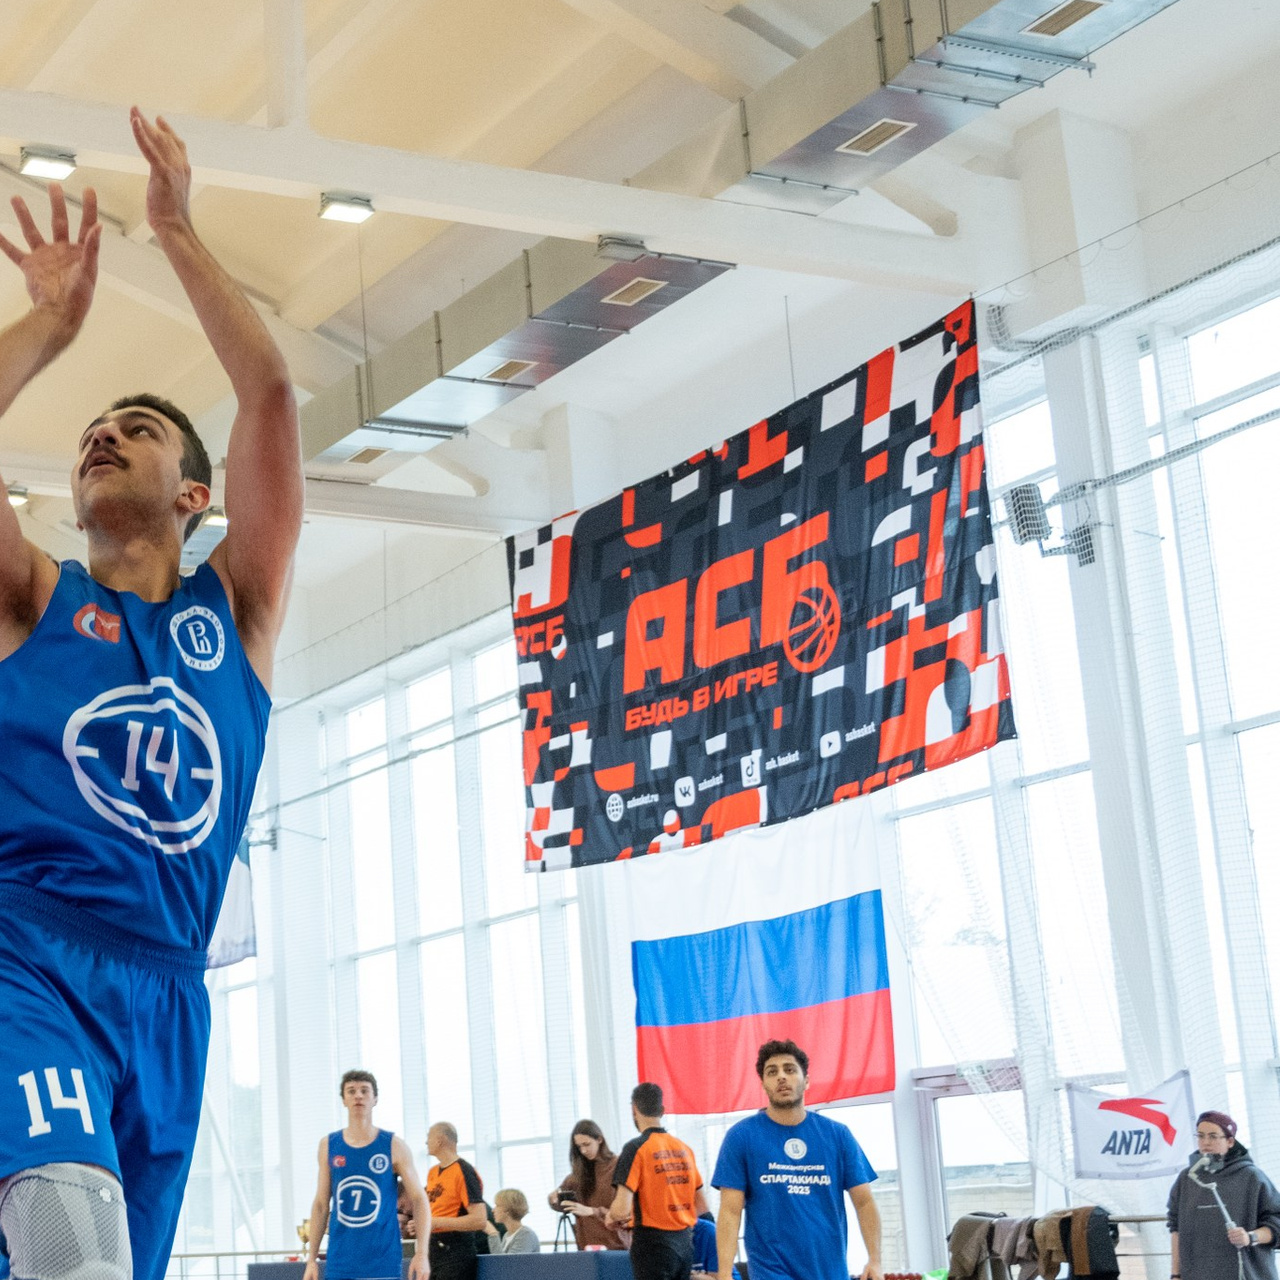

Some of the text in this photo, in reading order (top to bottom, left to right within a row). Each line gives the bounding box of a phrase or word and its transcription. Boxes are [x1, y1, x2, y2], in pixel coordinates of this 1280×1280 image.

[623, 511, 842, 694] АСБ
[625, 661, 778, 731] БУДЬ В ИГРЕ
[119, 719, 180, 802] 14
[18, 1066, 95, 1138] 14
[1101, 1128, 1151, 1155] ANTA
[768, 1162, 825, 1173] Межкампусная
[787, 1185, 811, 1195] 2023
[350, 1189, 362, 1211] 7
